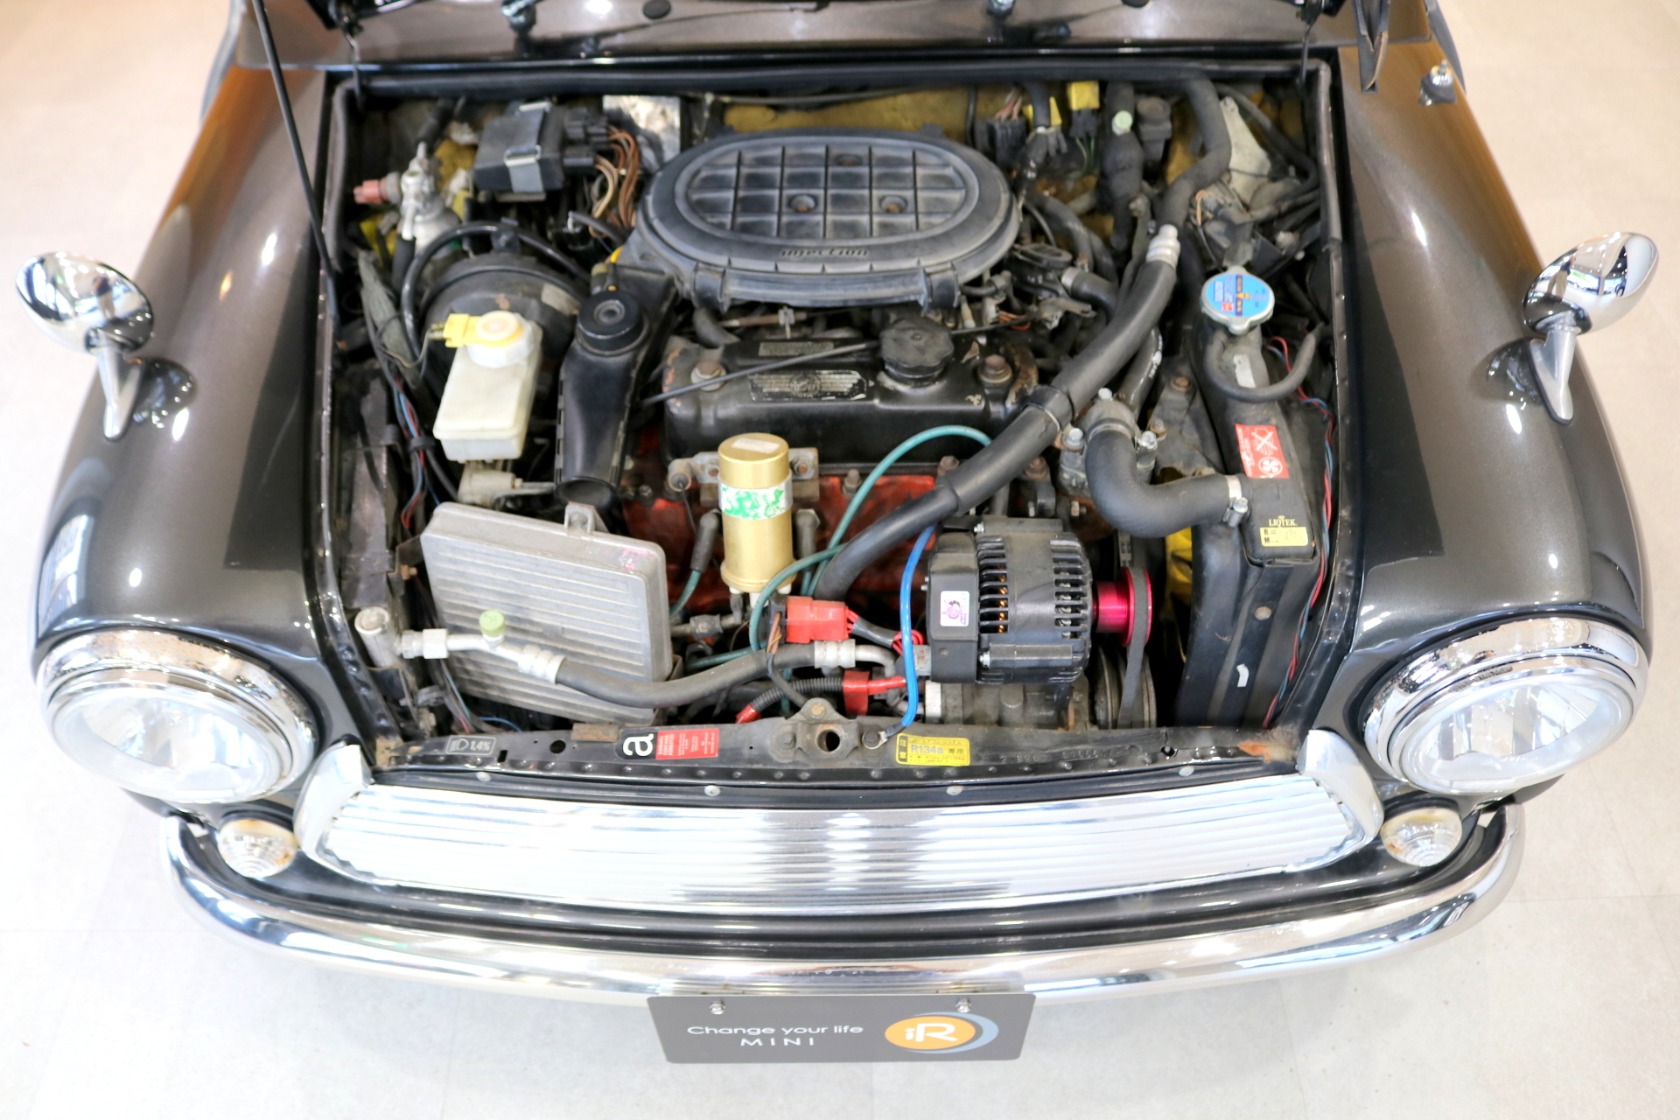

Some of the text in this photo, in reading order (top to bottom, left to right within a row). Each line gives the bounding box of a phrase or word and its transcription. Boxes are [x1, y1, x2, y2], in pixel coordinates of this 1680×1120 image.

[781, 247, 869, 259] injection
[911, 744, 944, 755] R134a
[687, 1025, 864, 1036] Change your life
[740, 1037, 815, 1047] MINI
